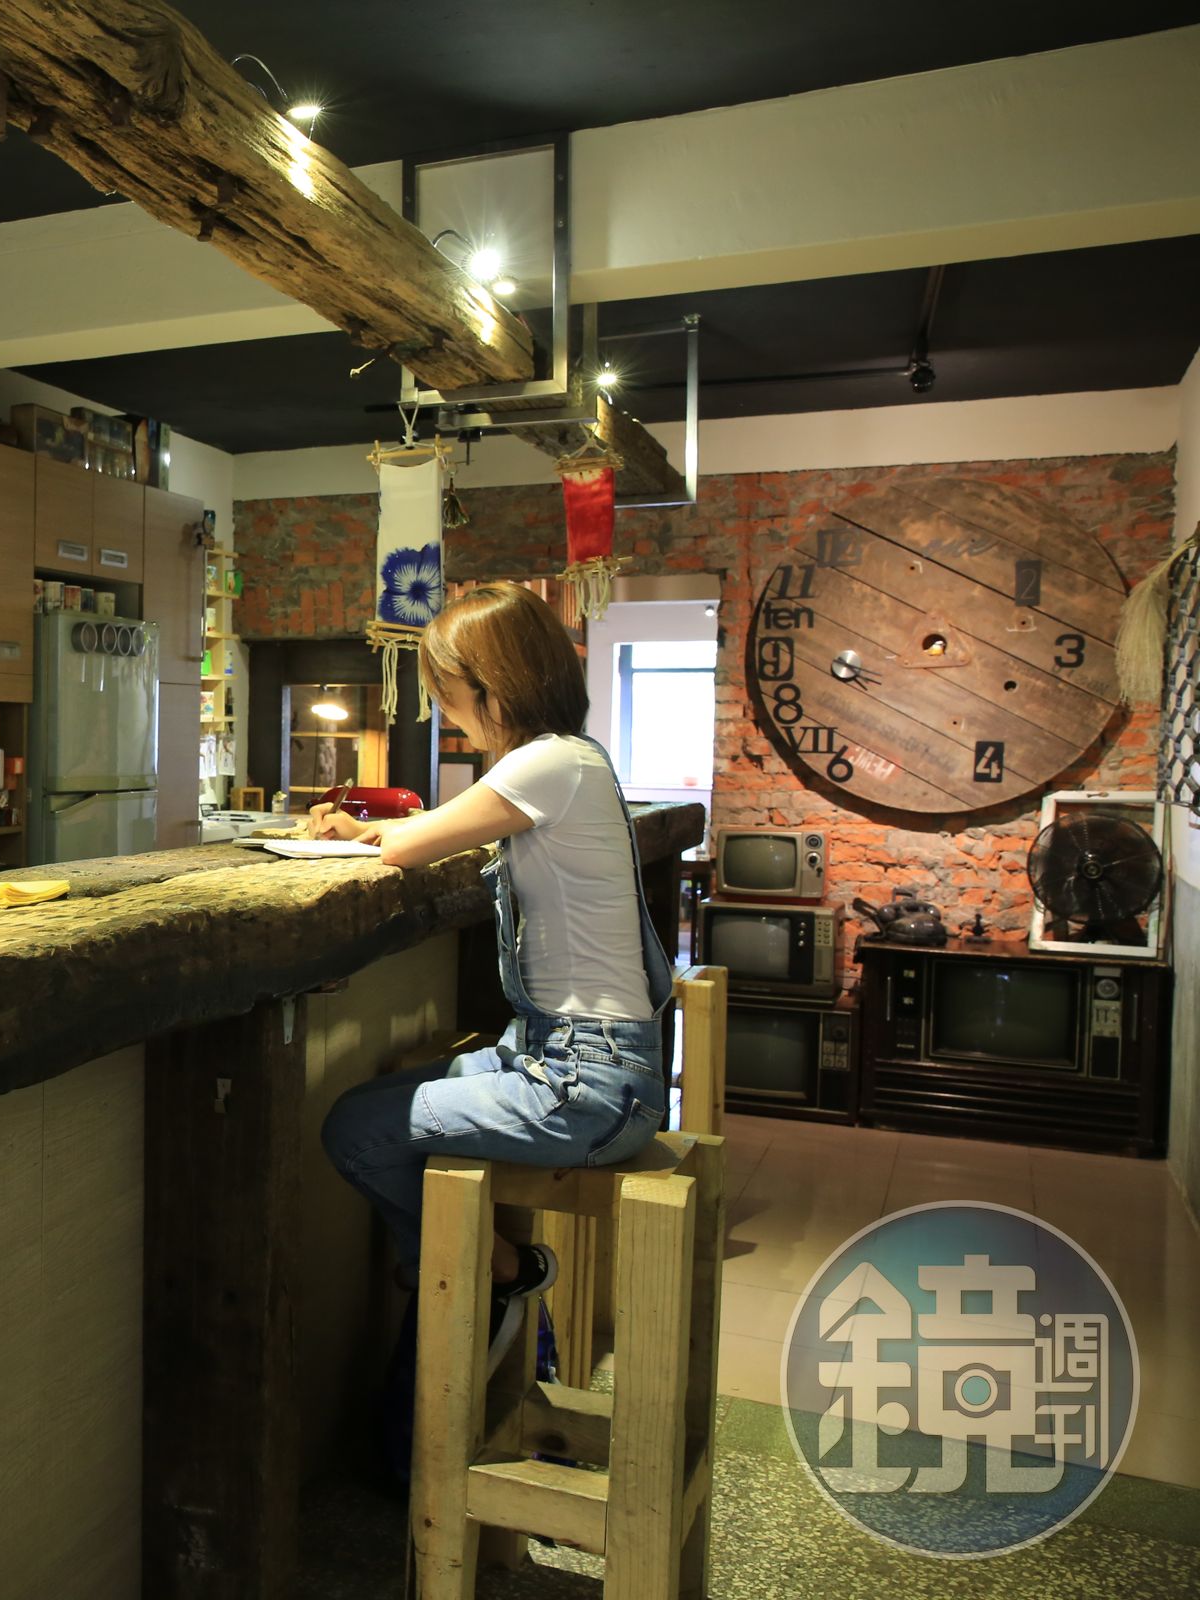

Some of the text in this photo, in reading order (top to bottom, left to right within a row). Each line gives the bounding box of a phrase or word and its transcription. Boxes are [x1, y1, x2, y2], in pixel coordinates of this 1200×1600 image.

[818, 530, 860, 566] 12
[770, 564, 816, 600] 11
[763, 601, 814, 630] ten
[762, 641, 791, 677] 9
[1054, 634, 1085, 668] 3
[773, 683, 803, 724] 8
[781, 726, 839, 754] VII
[827, 745, 853, 783] 6
[975, 746, 1001, 779] 4
